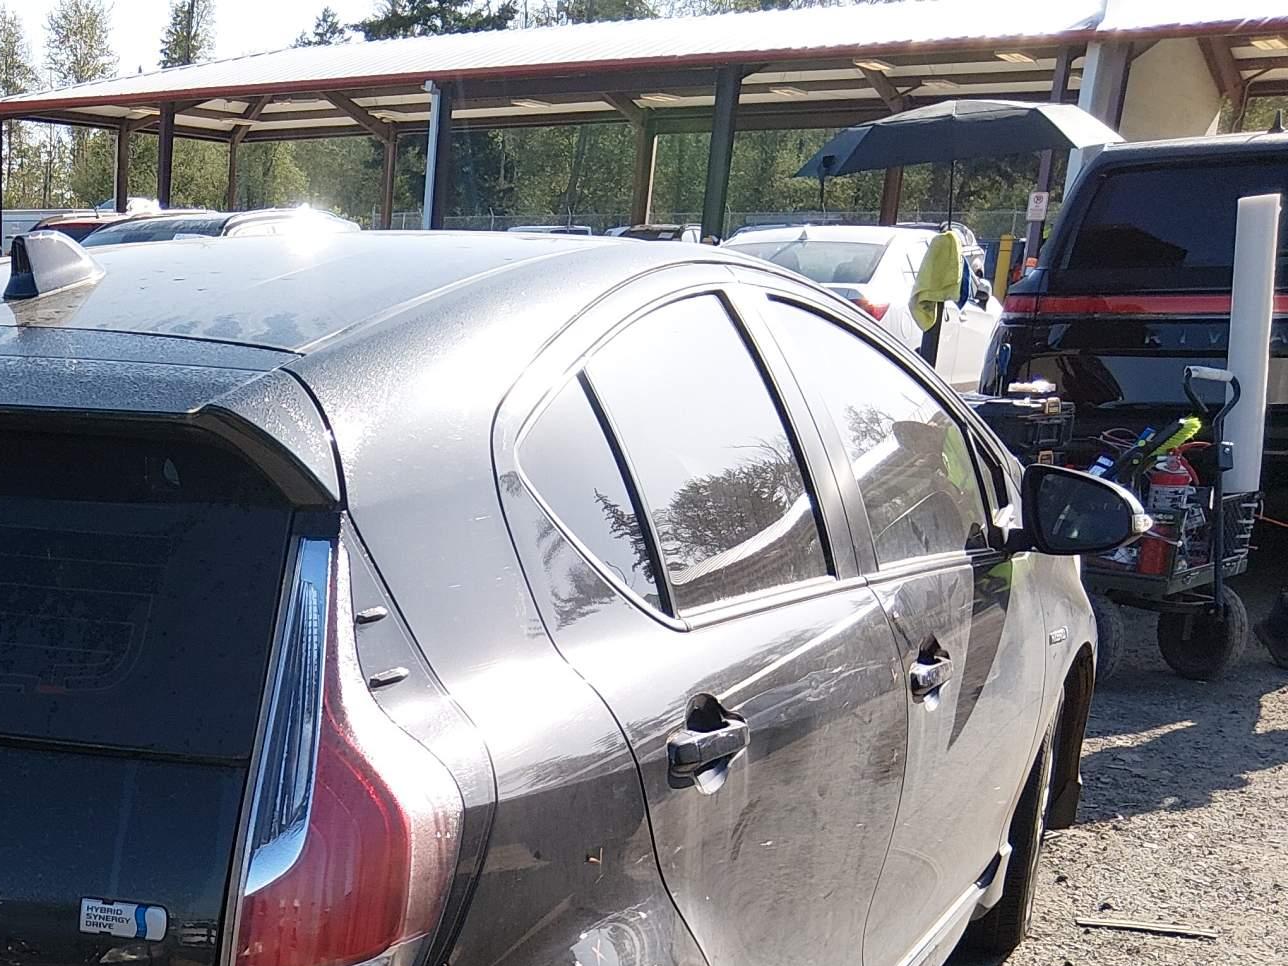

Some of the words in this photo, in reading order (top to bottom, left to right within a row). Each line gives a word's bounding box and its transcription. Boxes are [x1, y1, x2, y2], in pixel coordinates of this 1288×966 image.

[86, 904, 124, 916] HYBRID
[85, 912, 131, 925] SYNERGY
[85, 920, 115, 930] DRIVE
